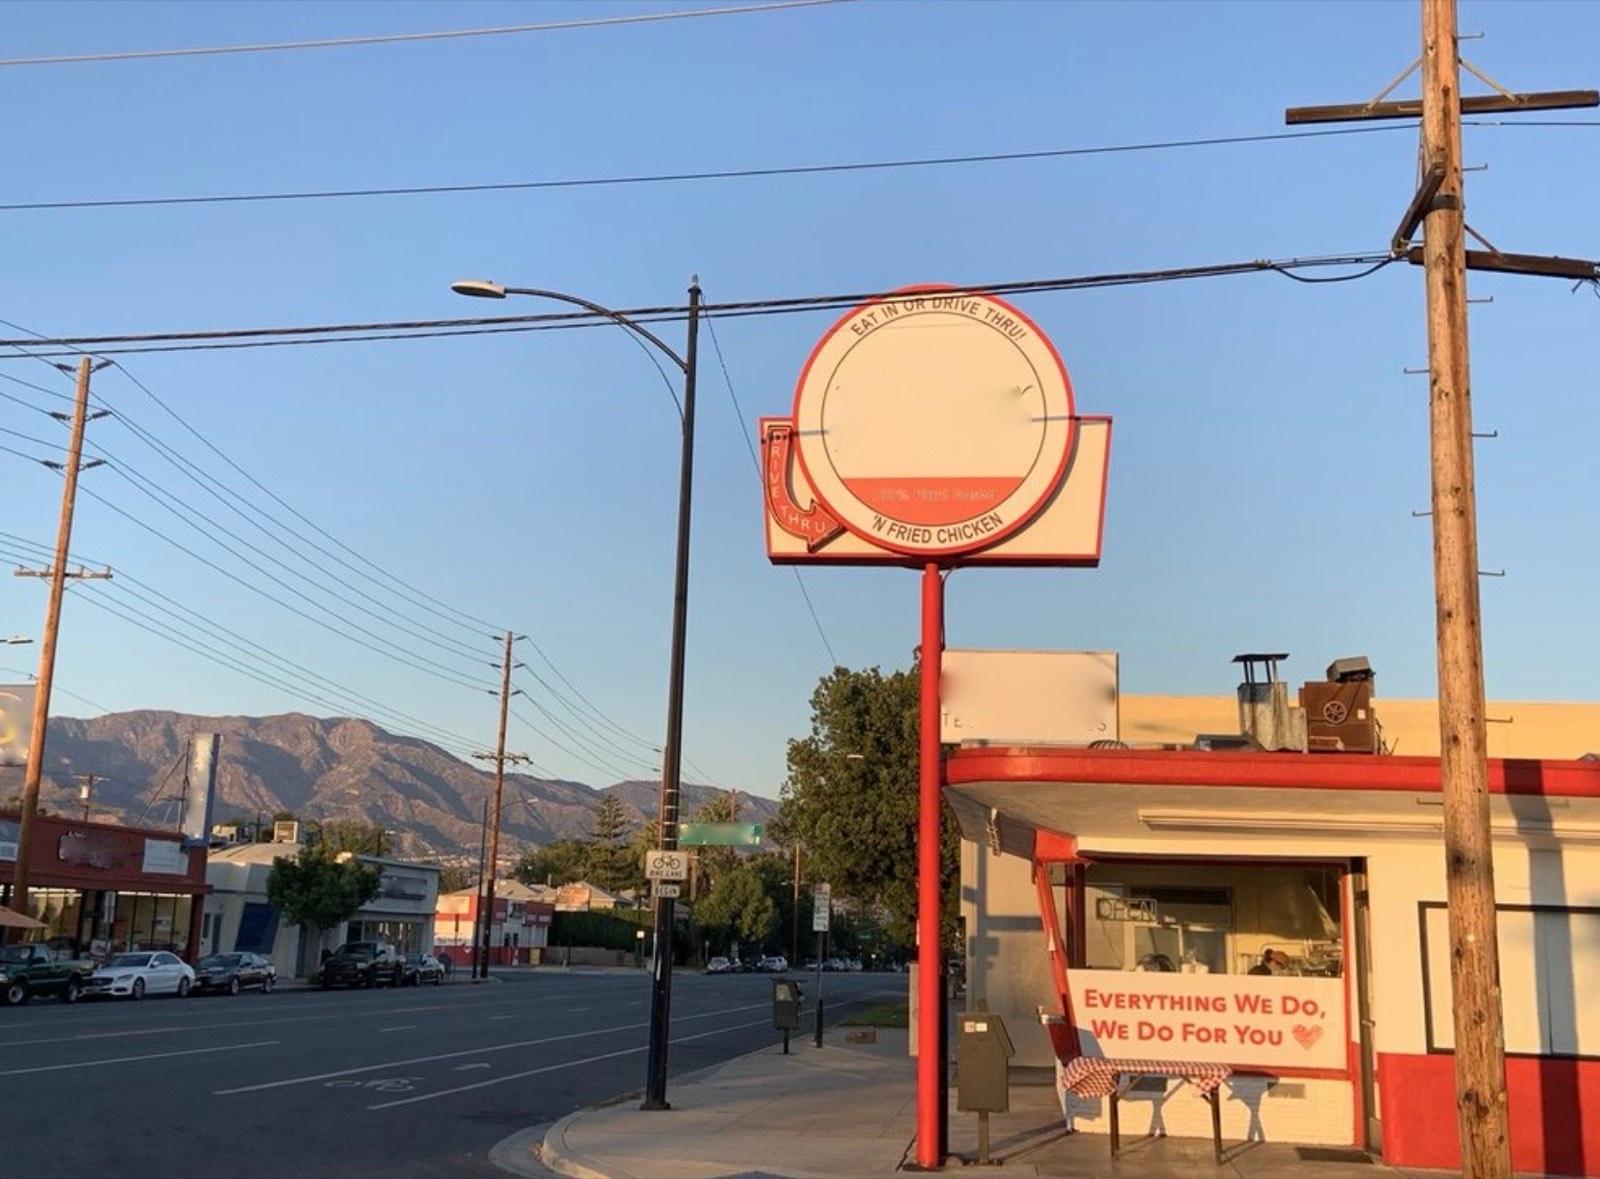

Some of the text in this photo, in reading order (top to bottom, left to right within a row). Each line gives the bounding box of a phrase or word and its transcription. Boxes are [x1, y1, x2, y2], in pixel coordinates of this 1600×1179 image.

[850, 297, 1027, 341] EAT IN OR DRIVE THRU!
[780, 506, 825, 533] THRU
[872, 512, 1004, 544] 'N FRIED CHICKEN
[1098, 900, 1156, 920] OPEN
[1084, 988, 1326, 1019] EVERYTHING WE DO,
[1091, 1019, 1284, 1046] WE DO FOR YOU
